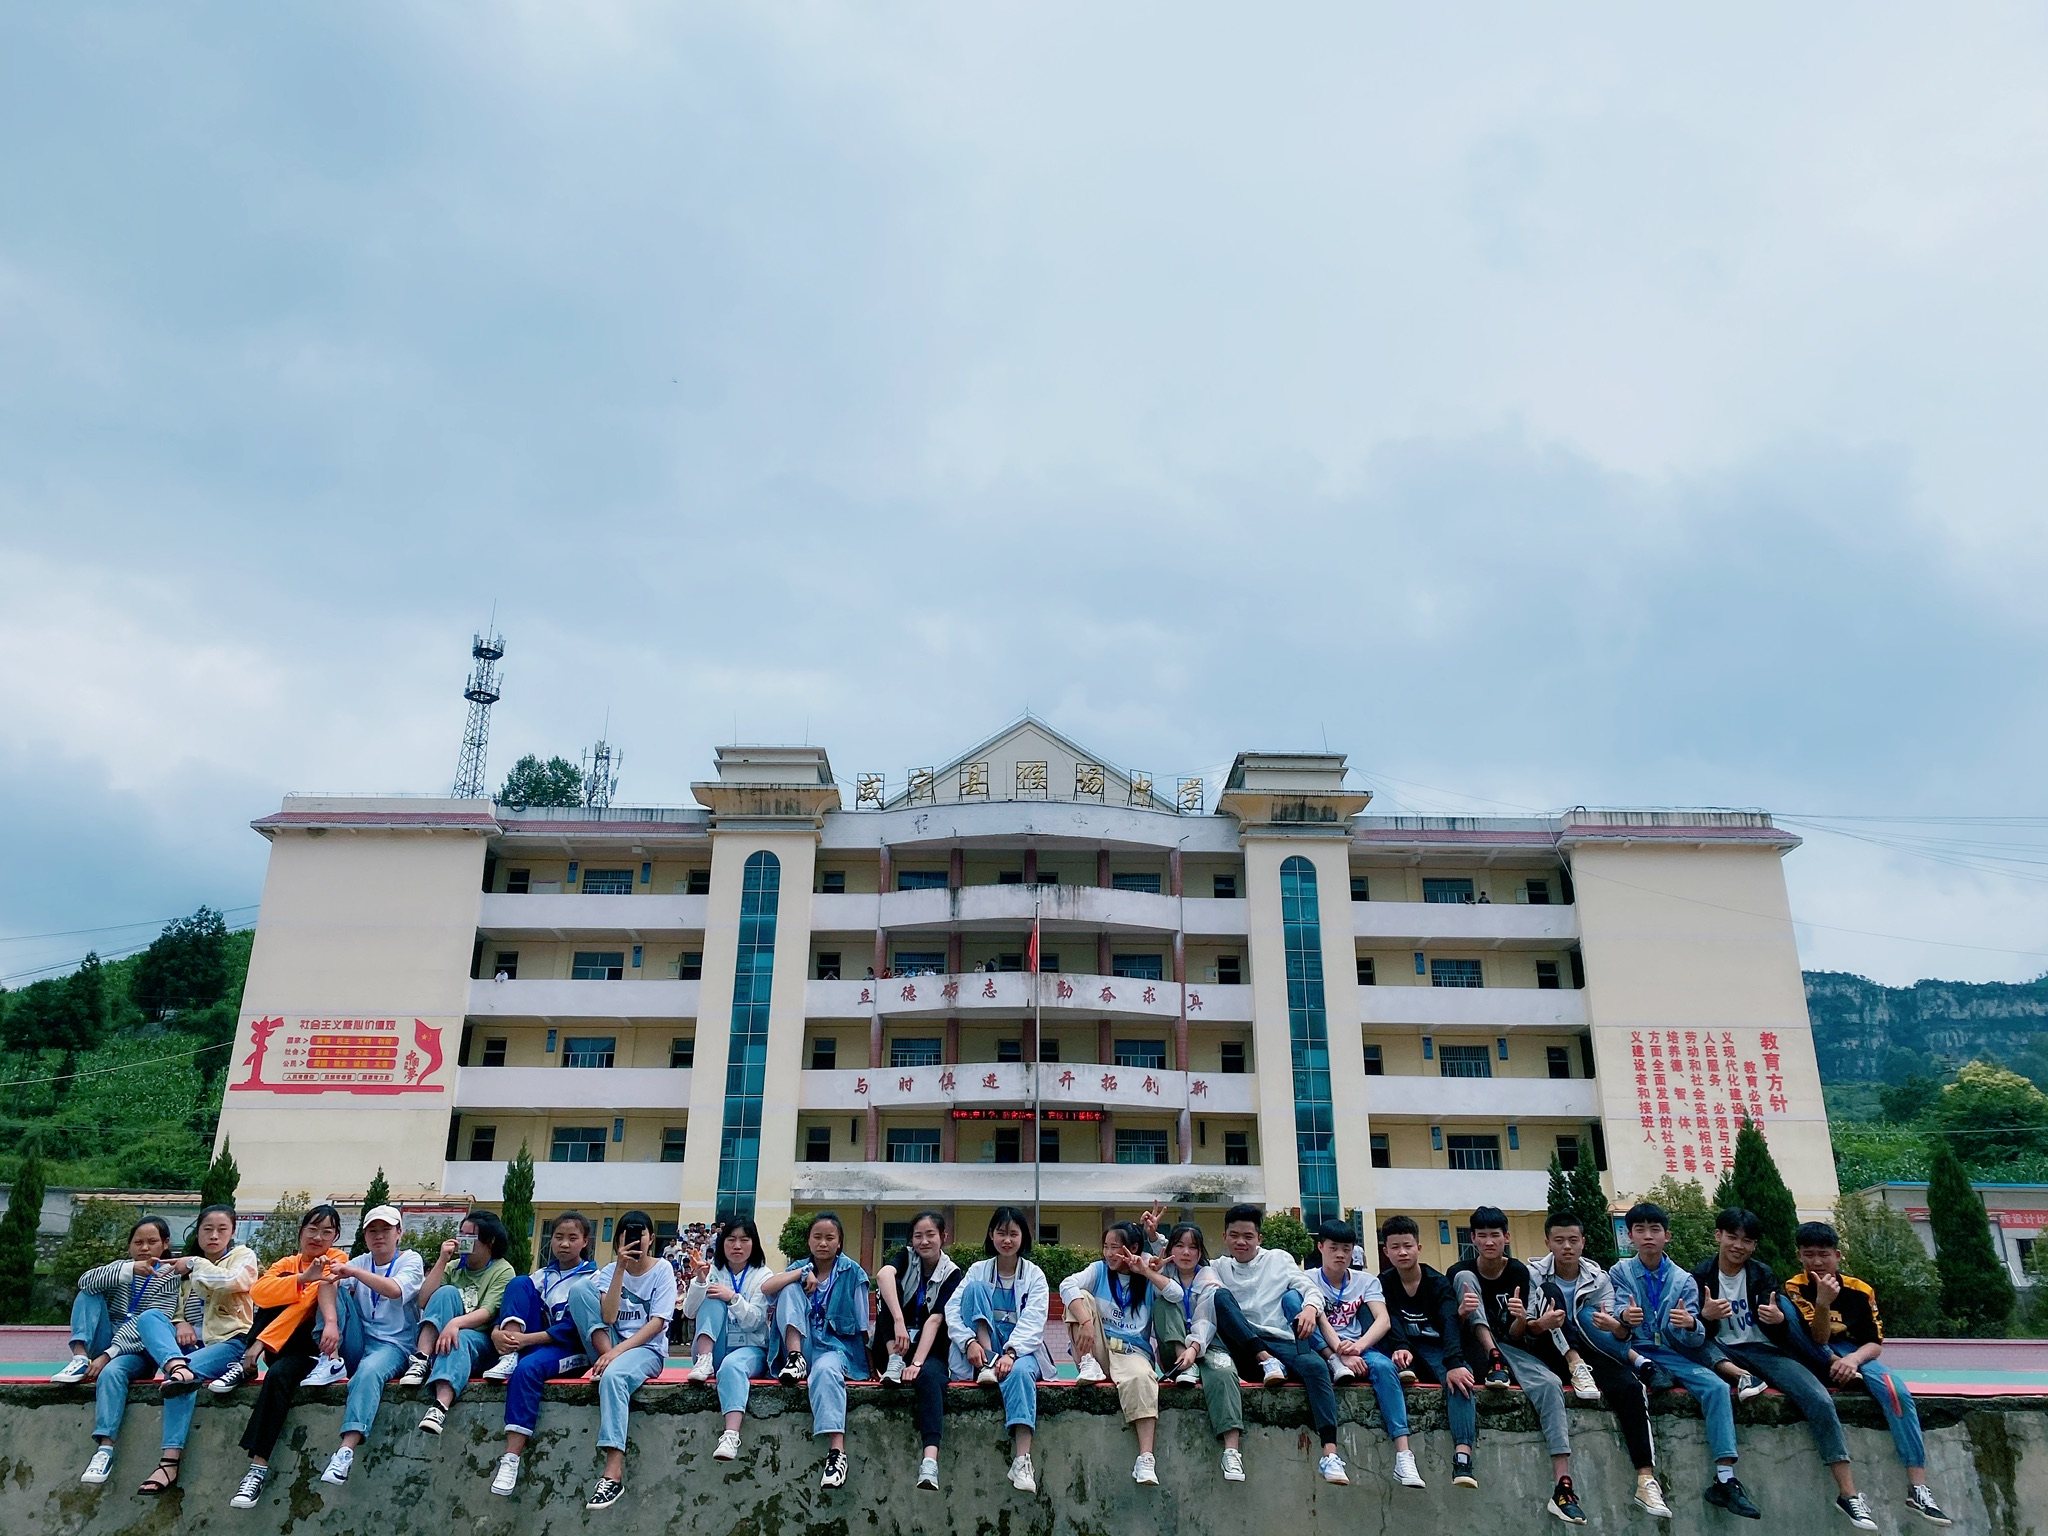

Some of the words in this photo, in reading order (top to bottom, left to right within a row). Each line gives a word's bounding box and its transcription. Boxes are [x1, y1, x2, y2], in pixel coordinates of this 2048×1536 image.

[300, 1019, 396, 1030] 社会主义核心价值观
[1760, 1031, 1788, 1113] 教育方针
[854, 1073, 1000, 1094] 与时俱进
[1059, 1071, 1208, 1099] 开拓创新
[1631, 1031, 1657, 1150] 义建设者和接班人。
[1649, 1031, 1679, 1173] 方面全面发展的社会主
[1667, 1031, 1697, 1173] 培养德、智、体、美等
[1685, 1031, 1717, 1179] 劳动和社会实践相结合，
[1722, 1032, 1746, 1136] 义现代化建设服
[617, 1310, 641, 1321] UMA
